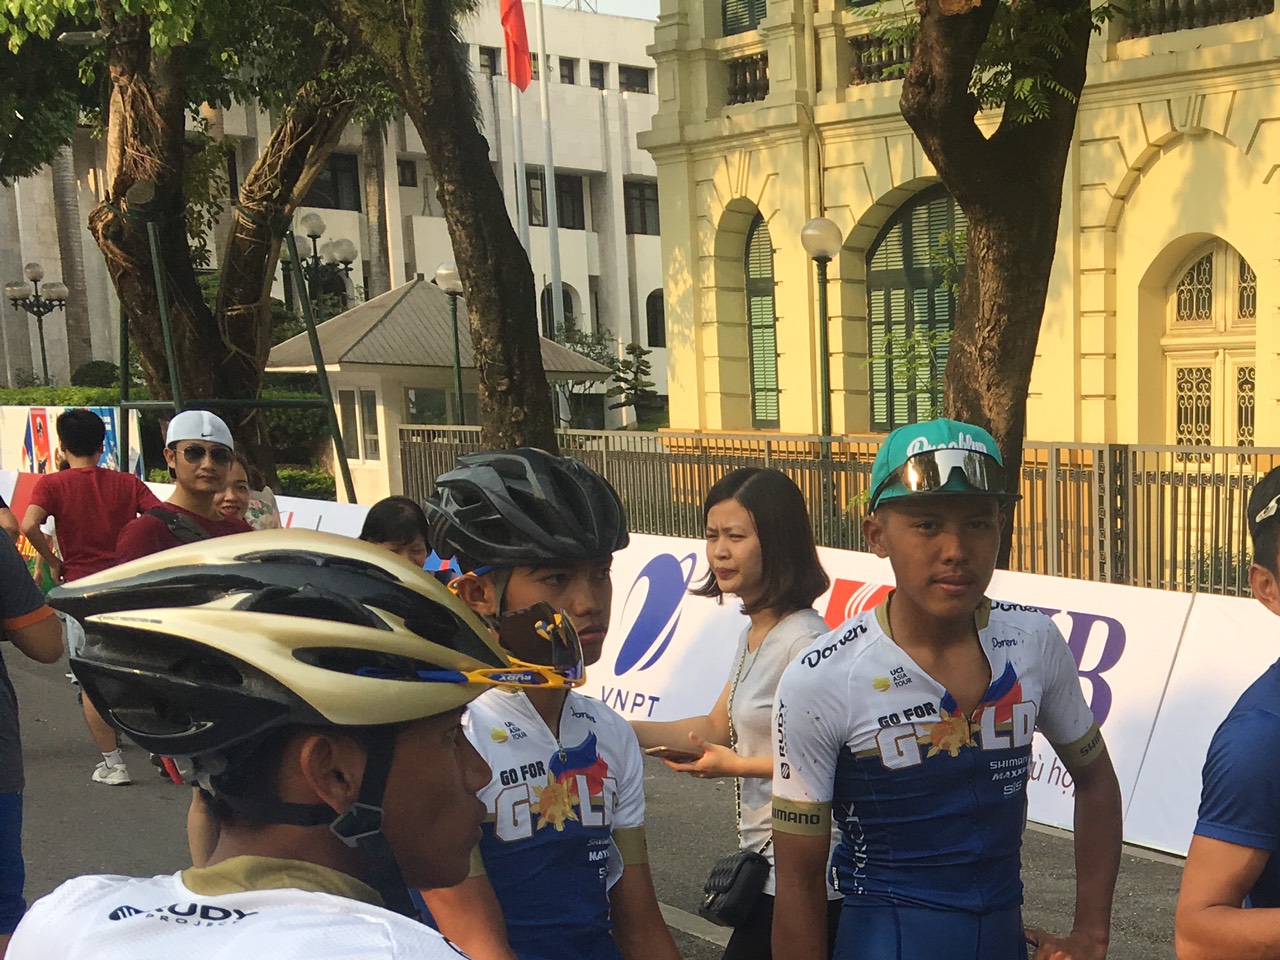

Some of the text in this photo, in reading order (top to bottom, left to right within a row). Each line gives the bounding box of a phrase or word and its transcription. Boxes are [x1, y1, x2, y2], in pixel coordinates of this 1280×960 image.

[801, 620, 867, 668] Donen
[601, 685, 661, 718] VNPT
[877, 702, 938, 728] GO FOR
[500, 760, 546, 787] GO FOR
